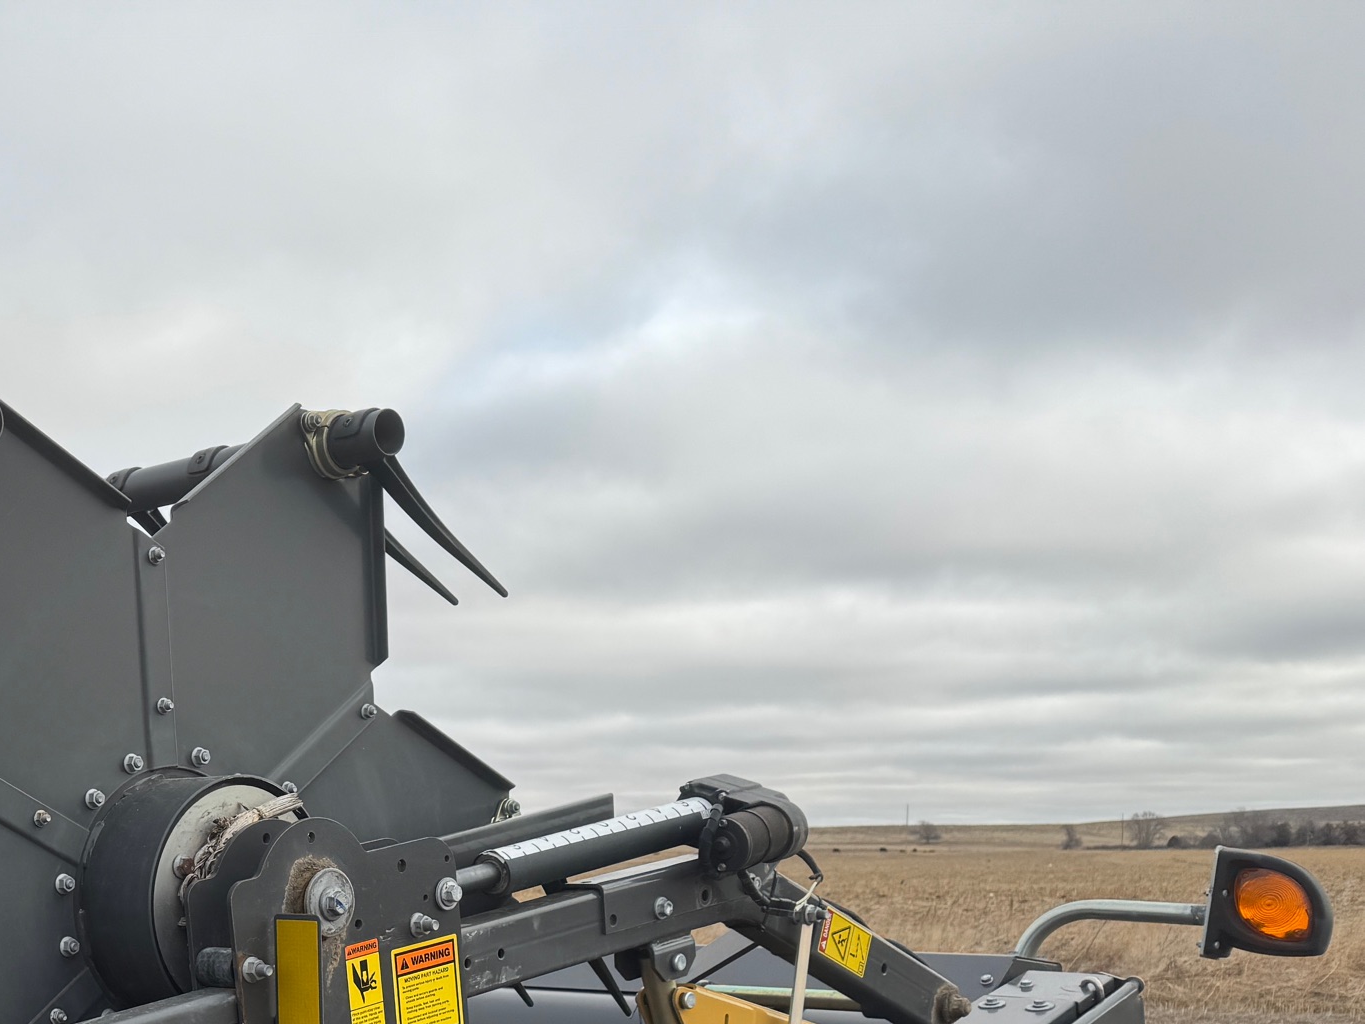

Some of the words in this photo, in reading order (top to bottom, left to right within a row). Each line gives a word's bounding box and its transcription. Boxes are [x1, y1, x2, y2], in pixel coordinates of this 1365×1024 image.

[351, 942, 377, 955] WARNING
[411, 948, 450, 966] WARNING
[404, 974, 421, 983] MOVING
[432, 967, 449, 975] HAZARD
